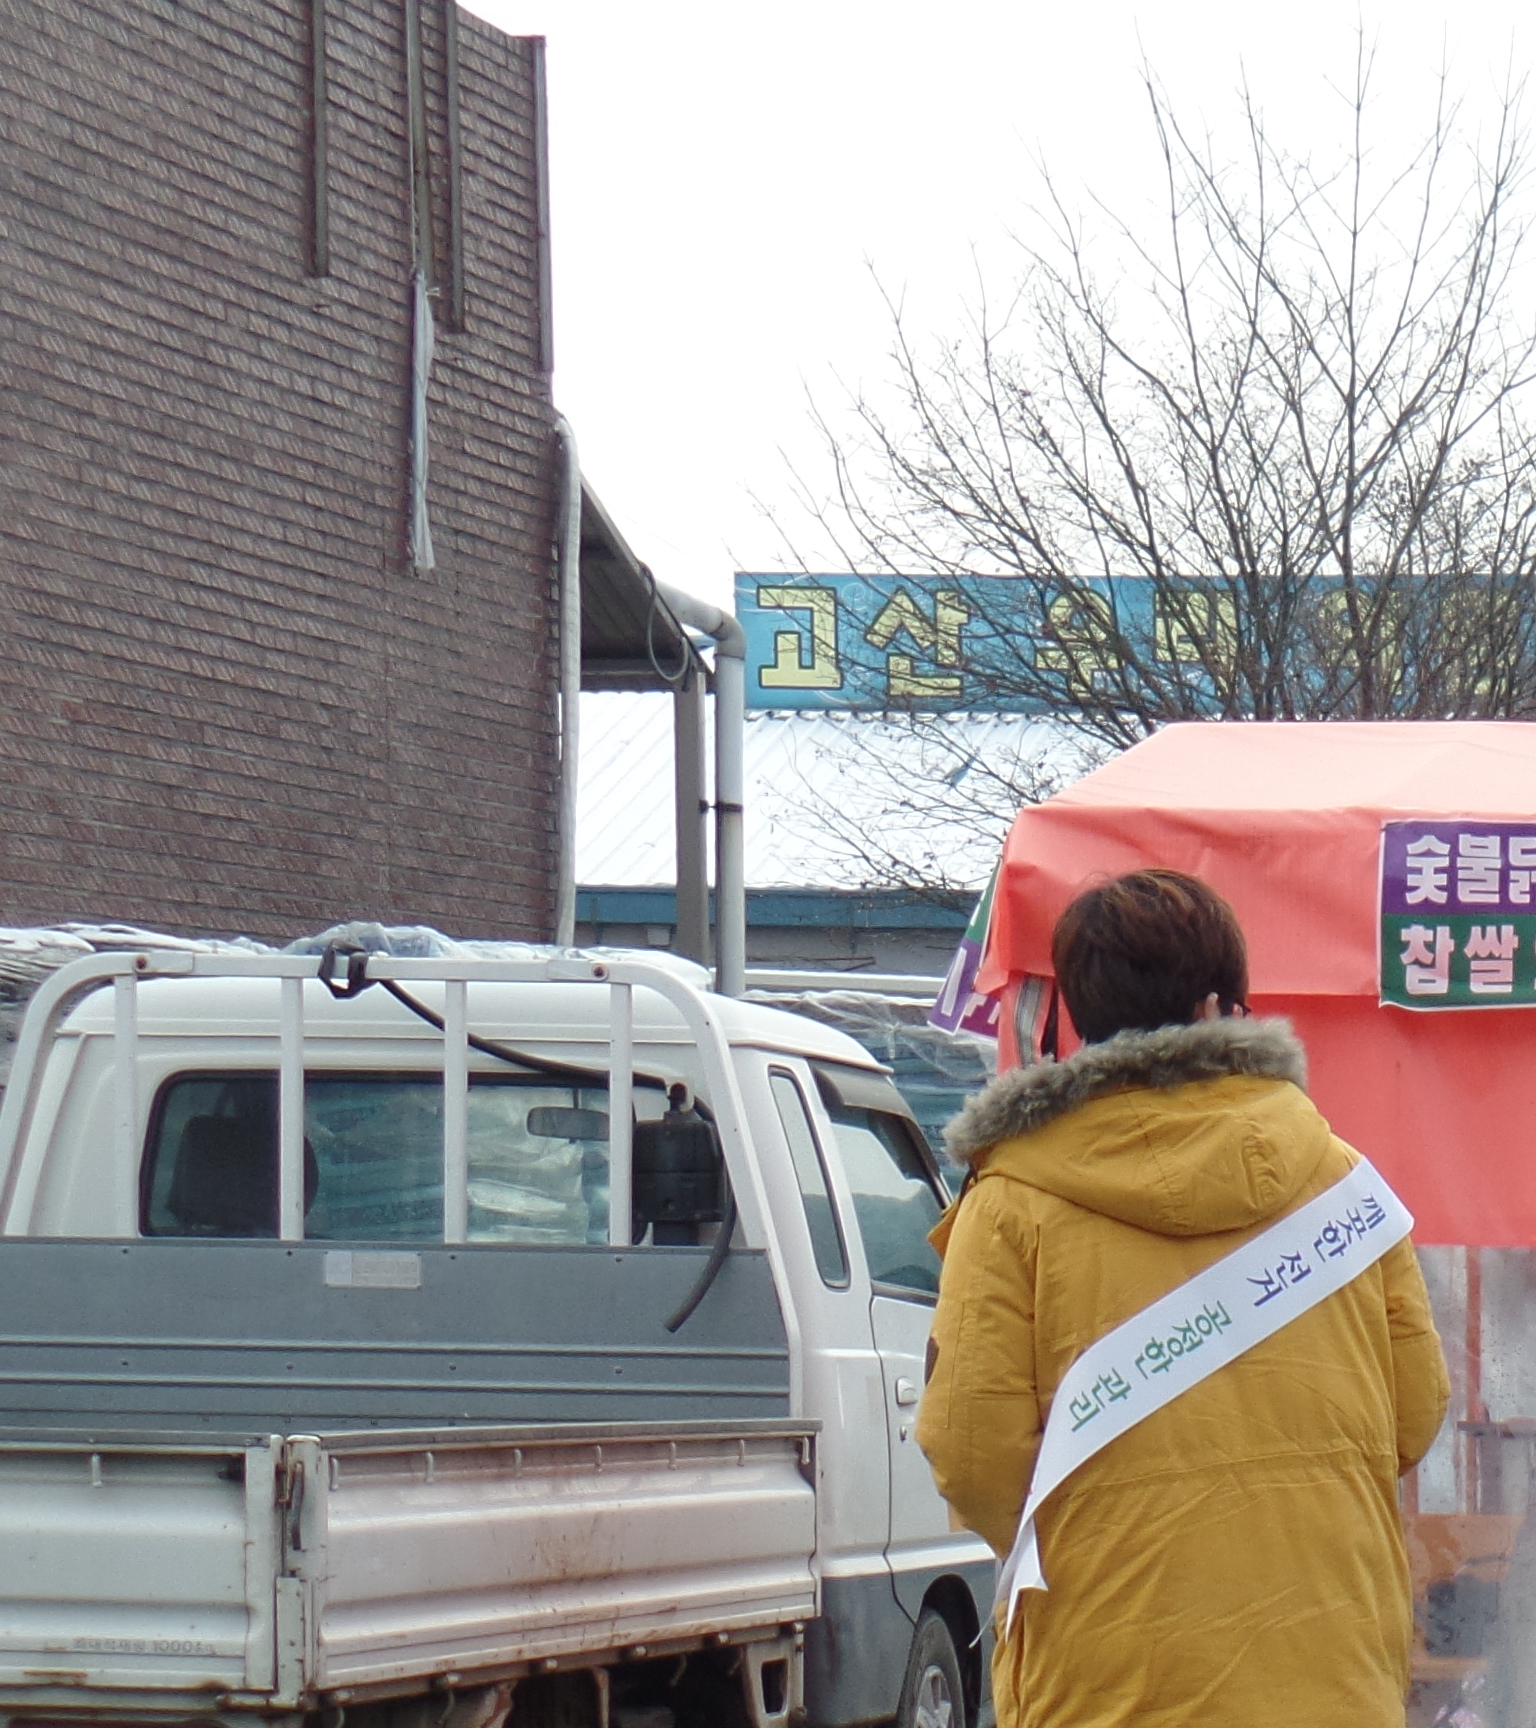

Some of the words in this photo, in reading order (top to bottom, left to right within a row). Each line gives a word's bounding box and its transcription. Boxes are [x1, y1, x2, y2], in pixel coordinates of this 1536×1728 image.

[756, 585, 971, 697] 고산
[1312, 1192, 1388, 1263] 깨끗한
[1246, 1250, 1312, 1307] 선거
[1135, 1300, 1232, 1380] 공정한
[1068, 1366, 1132, 1433] 관리
